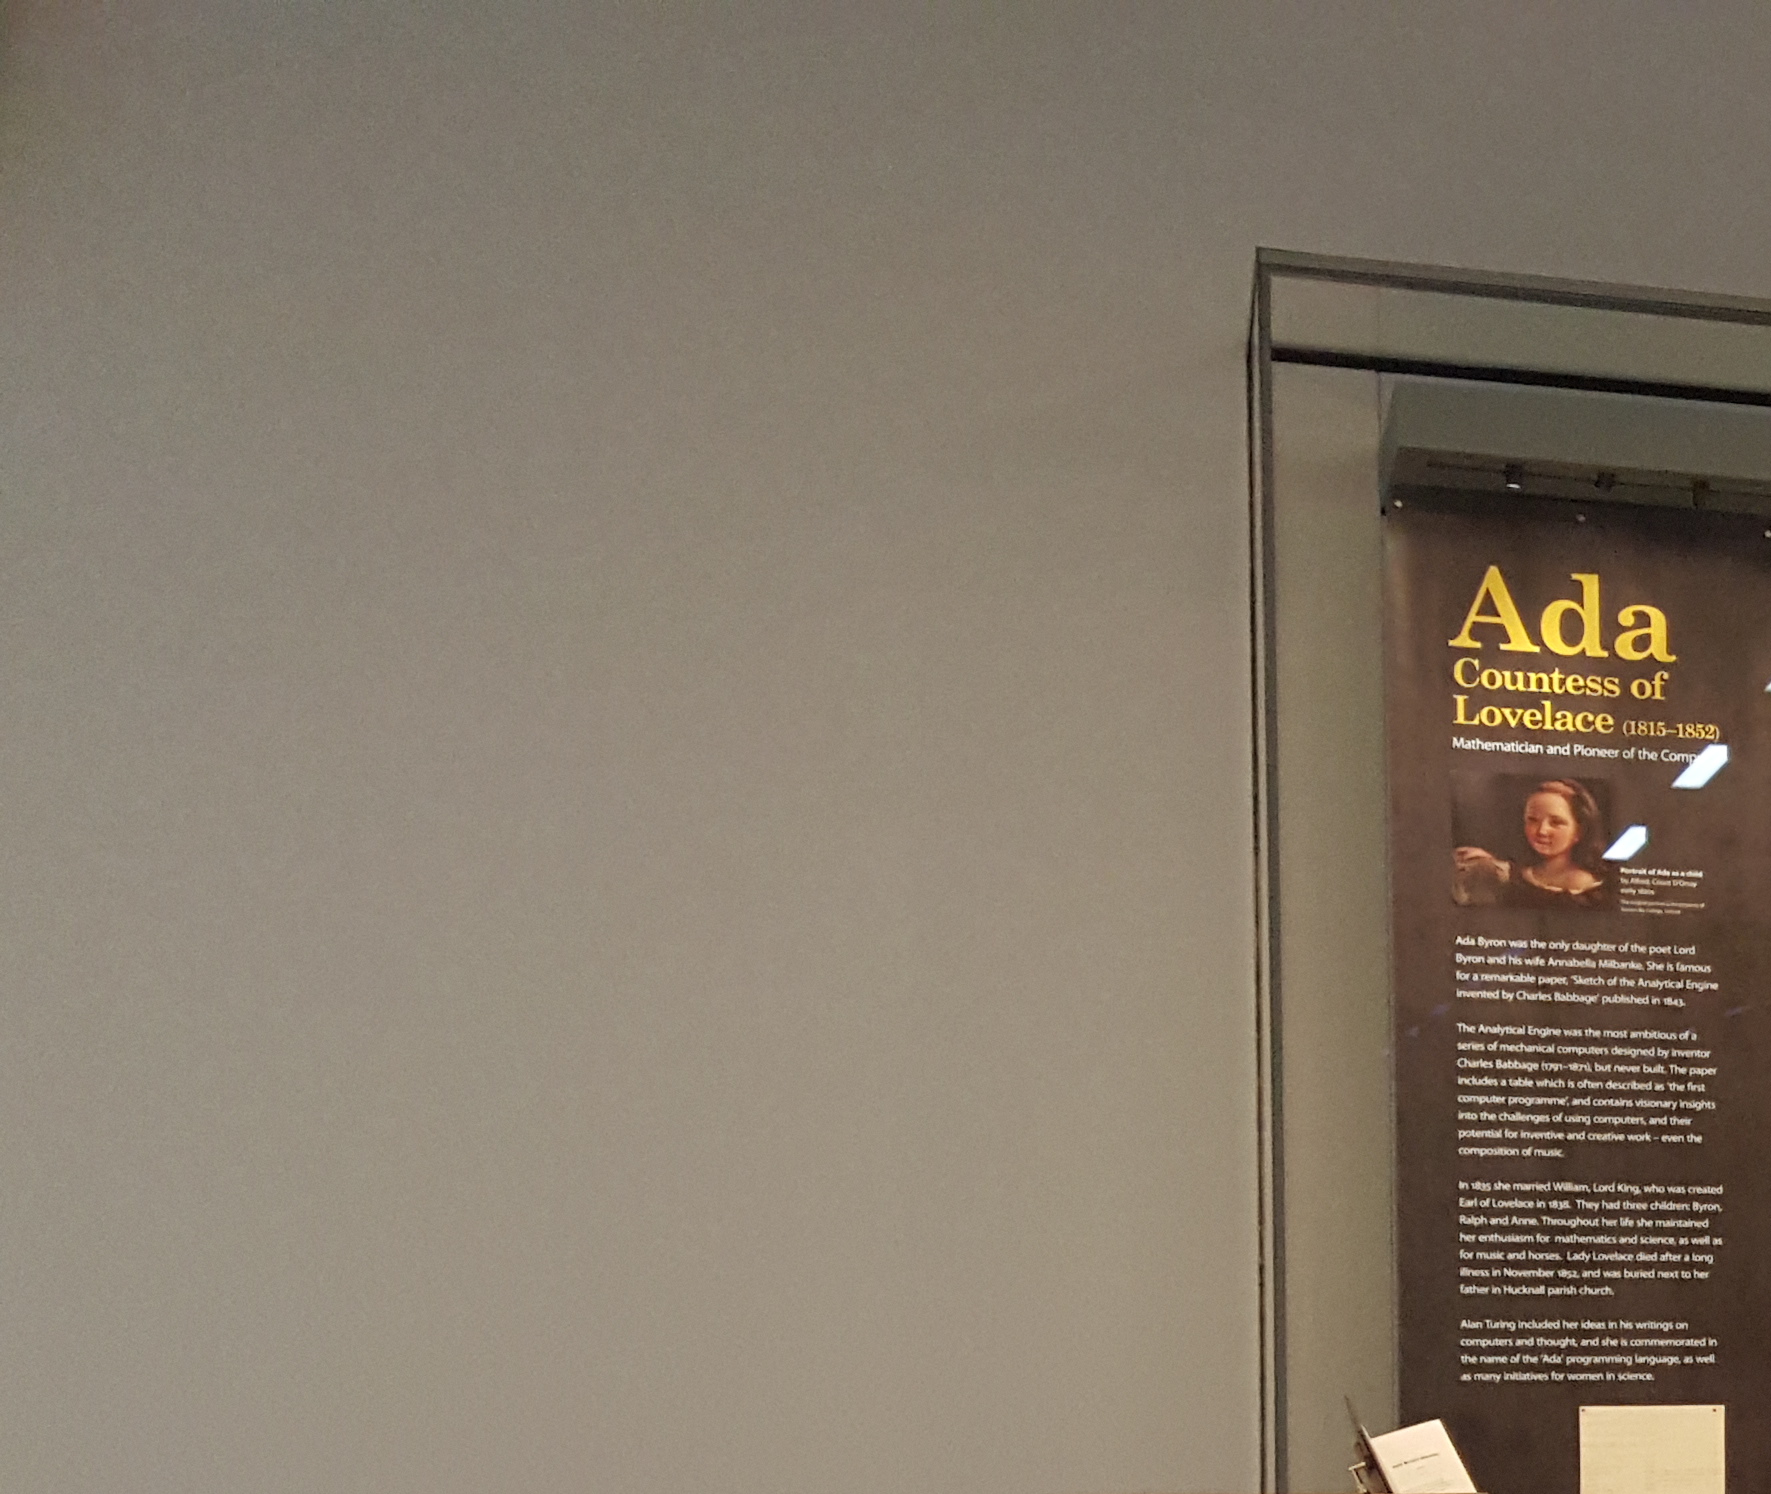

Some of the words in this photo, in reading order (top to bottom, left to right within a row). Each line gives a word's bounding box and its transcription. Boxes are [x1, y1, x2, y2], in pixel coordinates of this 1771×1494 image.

[1448, 565, 1677, 663] Ada
[1453, 657, 1620, 697] Countess
[1630, 671, 1669, 700] of
[1452, 694, 1615, 734] Lovelace
[1452, 737, 1543, 754] Mathematician
[1546, 743, 1570, 756] and
[1574, 744, 1619, 758] Pioneer
[1622, 747, 1635, 759] of
[1638, 748, 1658, 760] the
